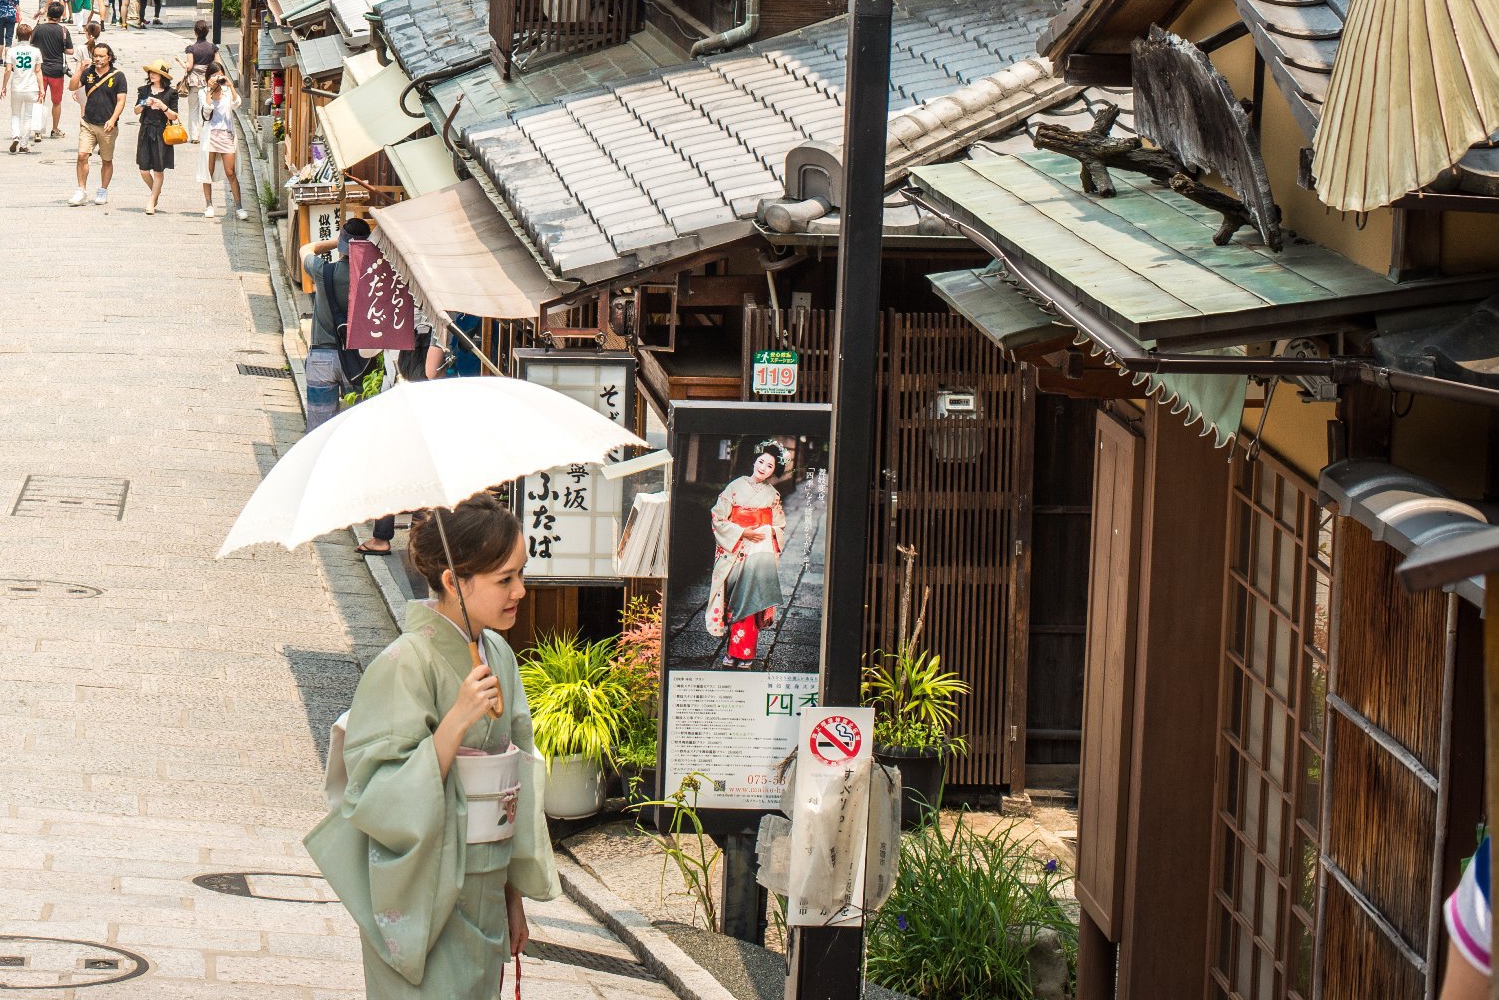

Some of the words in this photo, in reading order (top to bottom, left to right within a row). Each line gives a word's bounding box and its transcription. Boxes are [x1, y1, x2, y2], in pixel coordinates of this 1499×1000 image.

[16, 55, 32, 69] 32
[367, 272, 387, 338] だんご
[757, 366, 794, 386] 119
[528, 472, 562, 558] ふたば
